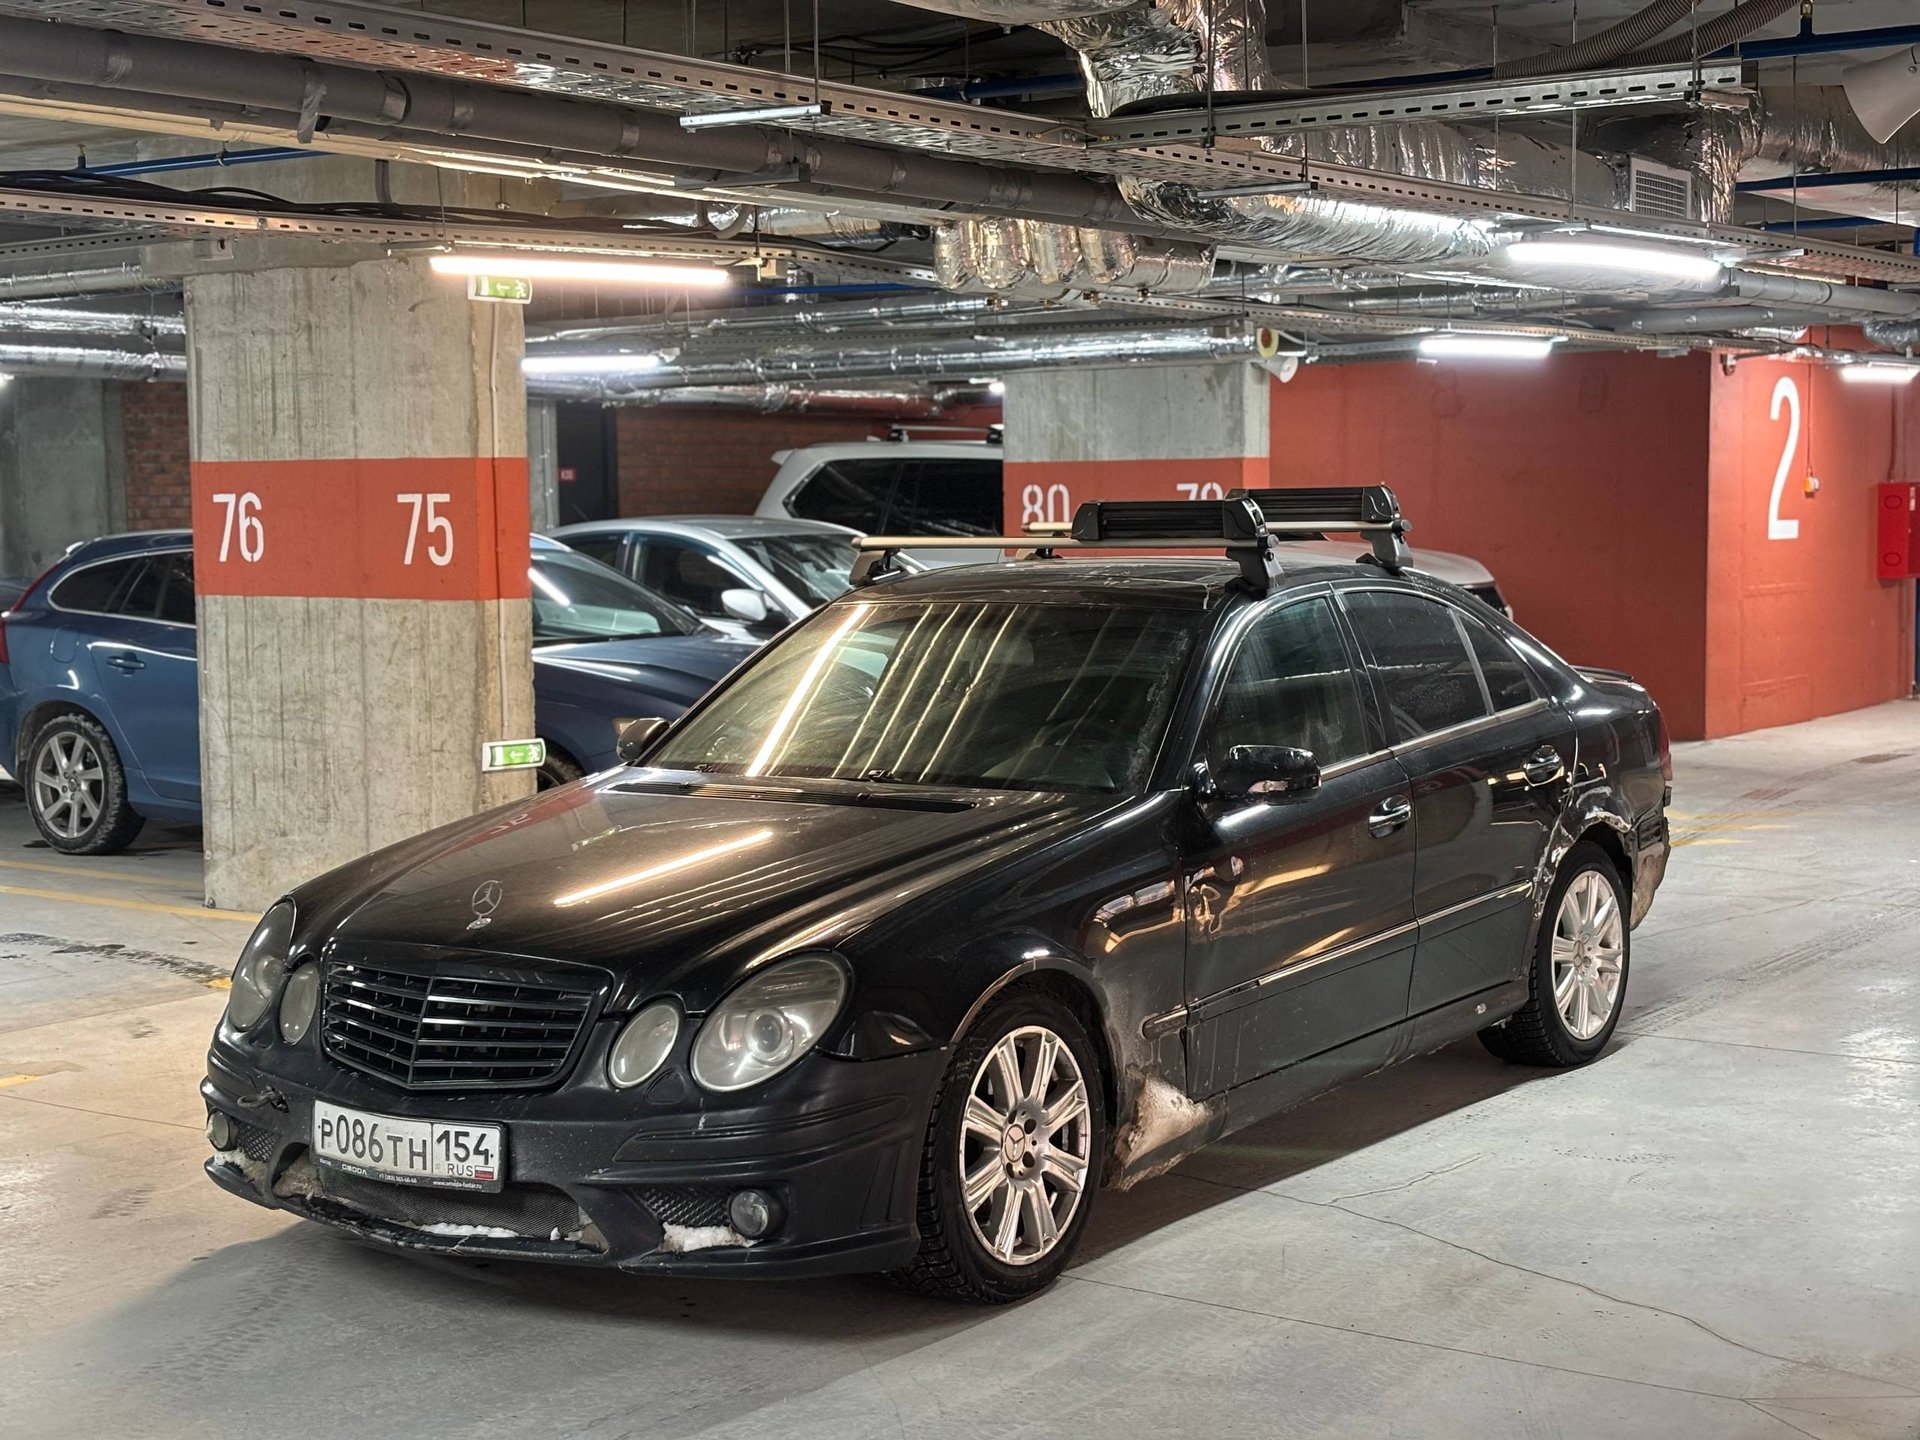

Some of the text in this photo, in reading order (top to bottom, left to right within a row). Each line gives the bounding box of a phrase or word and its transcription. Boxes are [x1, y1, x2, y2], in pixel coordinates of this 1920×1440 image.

[1768, 376, 1800, 540] 2
[213, 492, 264, 562] 76
[397, 493, 454, 566] 75
[436, 1130, 490, 1165] 154
[448, 1164, 473, 1177] RUS
